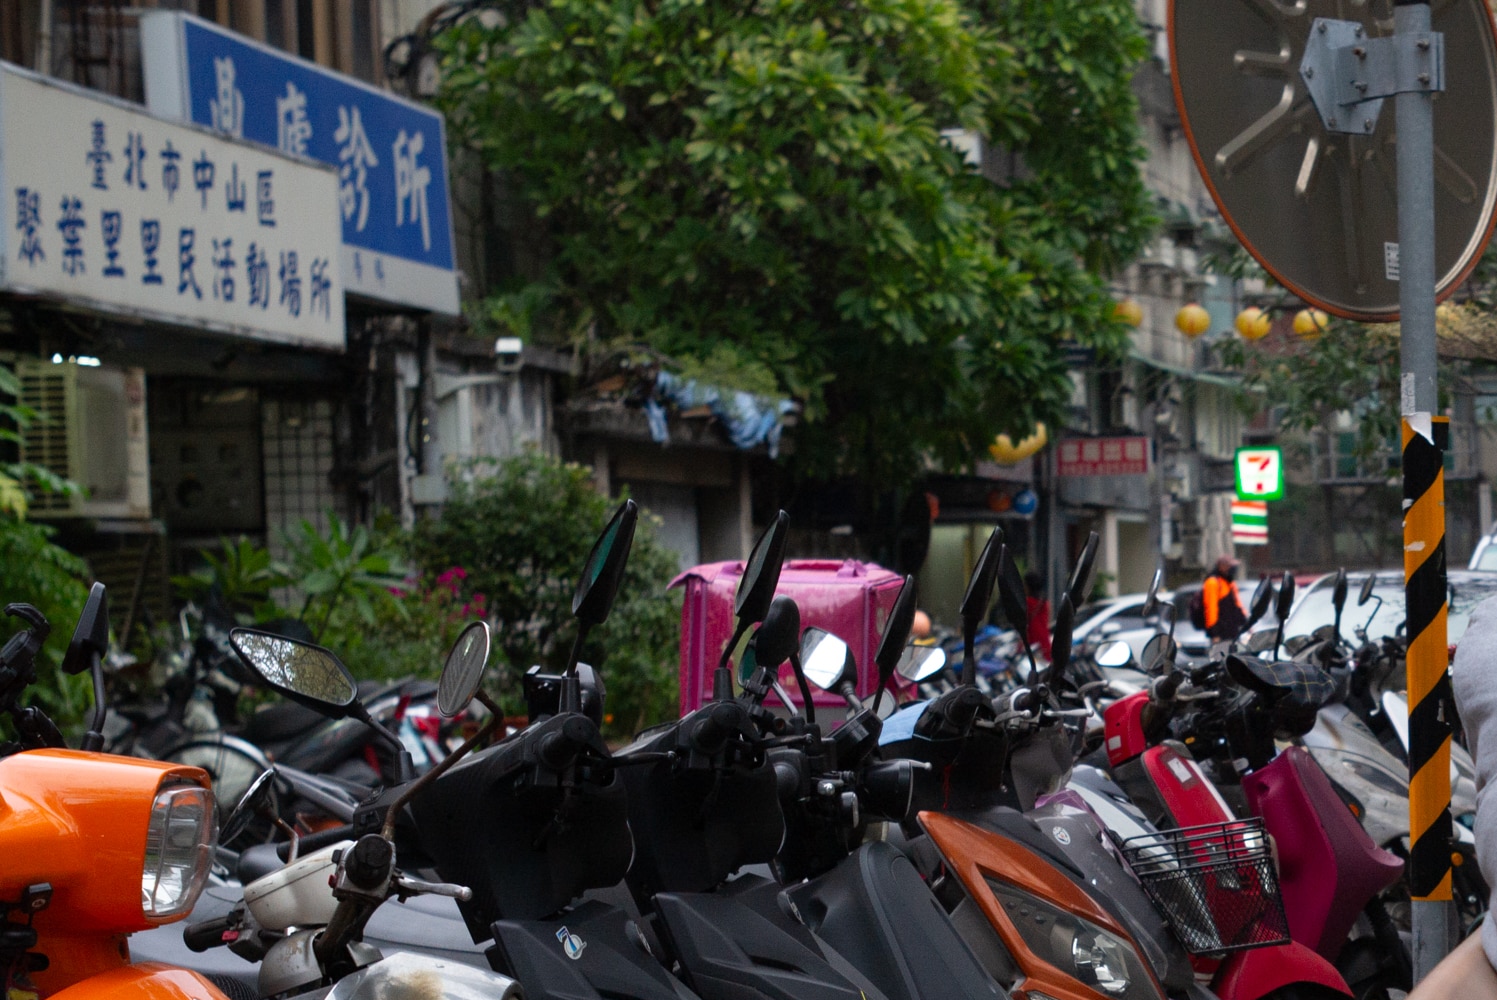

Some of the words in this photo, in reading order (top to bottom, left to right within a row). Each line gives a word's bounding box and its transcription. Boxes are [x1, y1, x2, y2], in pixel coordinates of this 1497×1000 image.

[86, 119, 276, 228] 臺北市中山區
